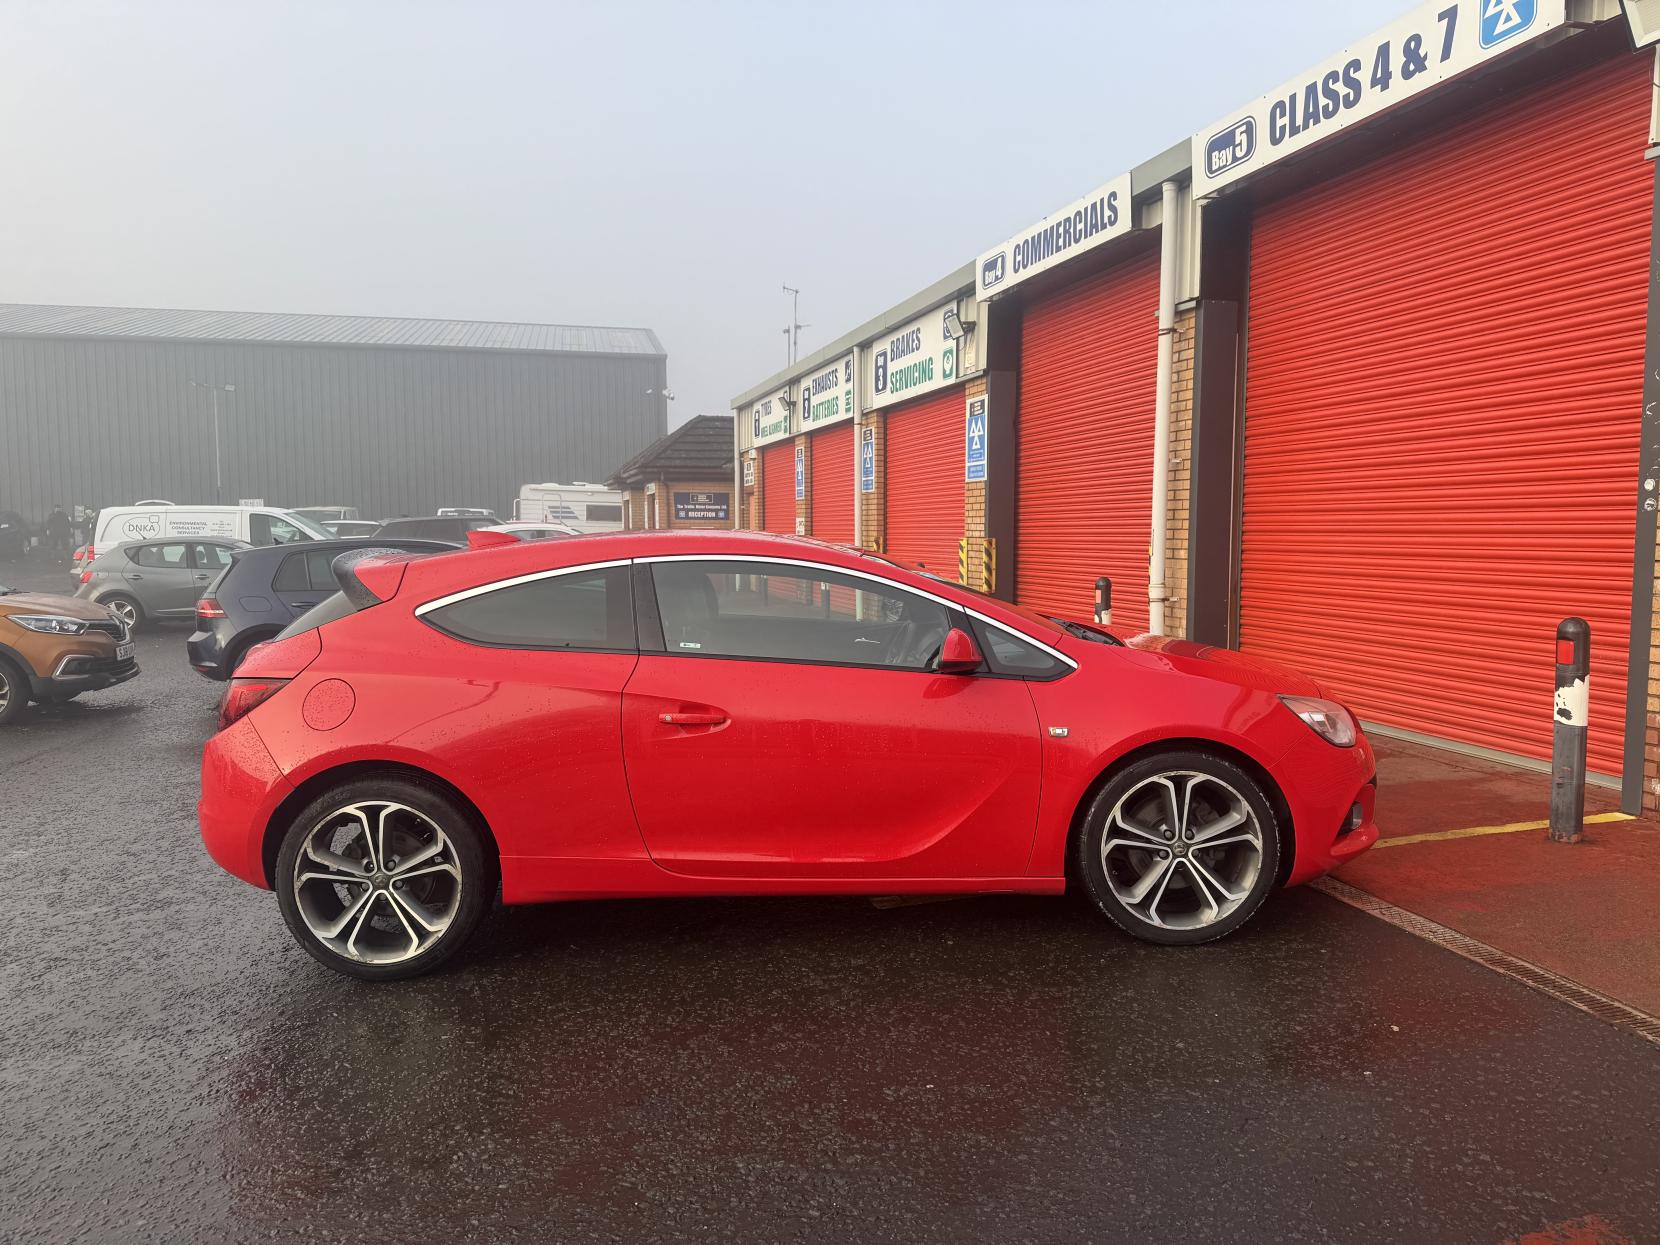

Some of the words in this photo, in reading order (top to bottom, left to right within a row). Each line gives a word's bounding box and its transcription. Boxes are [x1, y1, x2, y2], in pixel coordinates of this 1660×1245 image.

[1269, 58, 1362, 146] CLASS
[1369, 40, 1393, 92] 4
[1401, 33, 1428, 81] &
[1437, 3, 1459, 63] 7
[1211, 145, 1232, 171] Bay
[1234, 124, 1248, 158] 5
[1012, 190, 1119, 274] COMMERCIALS
[984, 268, 996, 285] Bay
[995, 257, 1002, 280] 4
[890, 327, 921, 362] BRAKES
[812, 367, 839, 396] EXHAUSTS
[878, 367, 884, 390] 3
[890, 356, 934, 394] SERVICING
[760, 399, 772, 418] TYRES
[804, 400, 809, 418] 2
[812, 395, 839, 422] BATTERIES
[128, 523, 156, 532] DNKA
